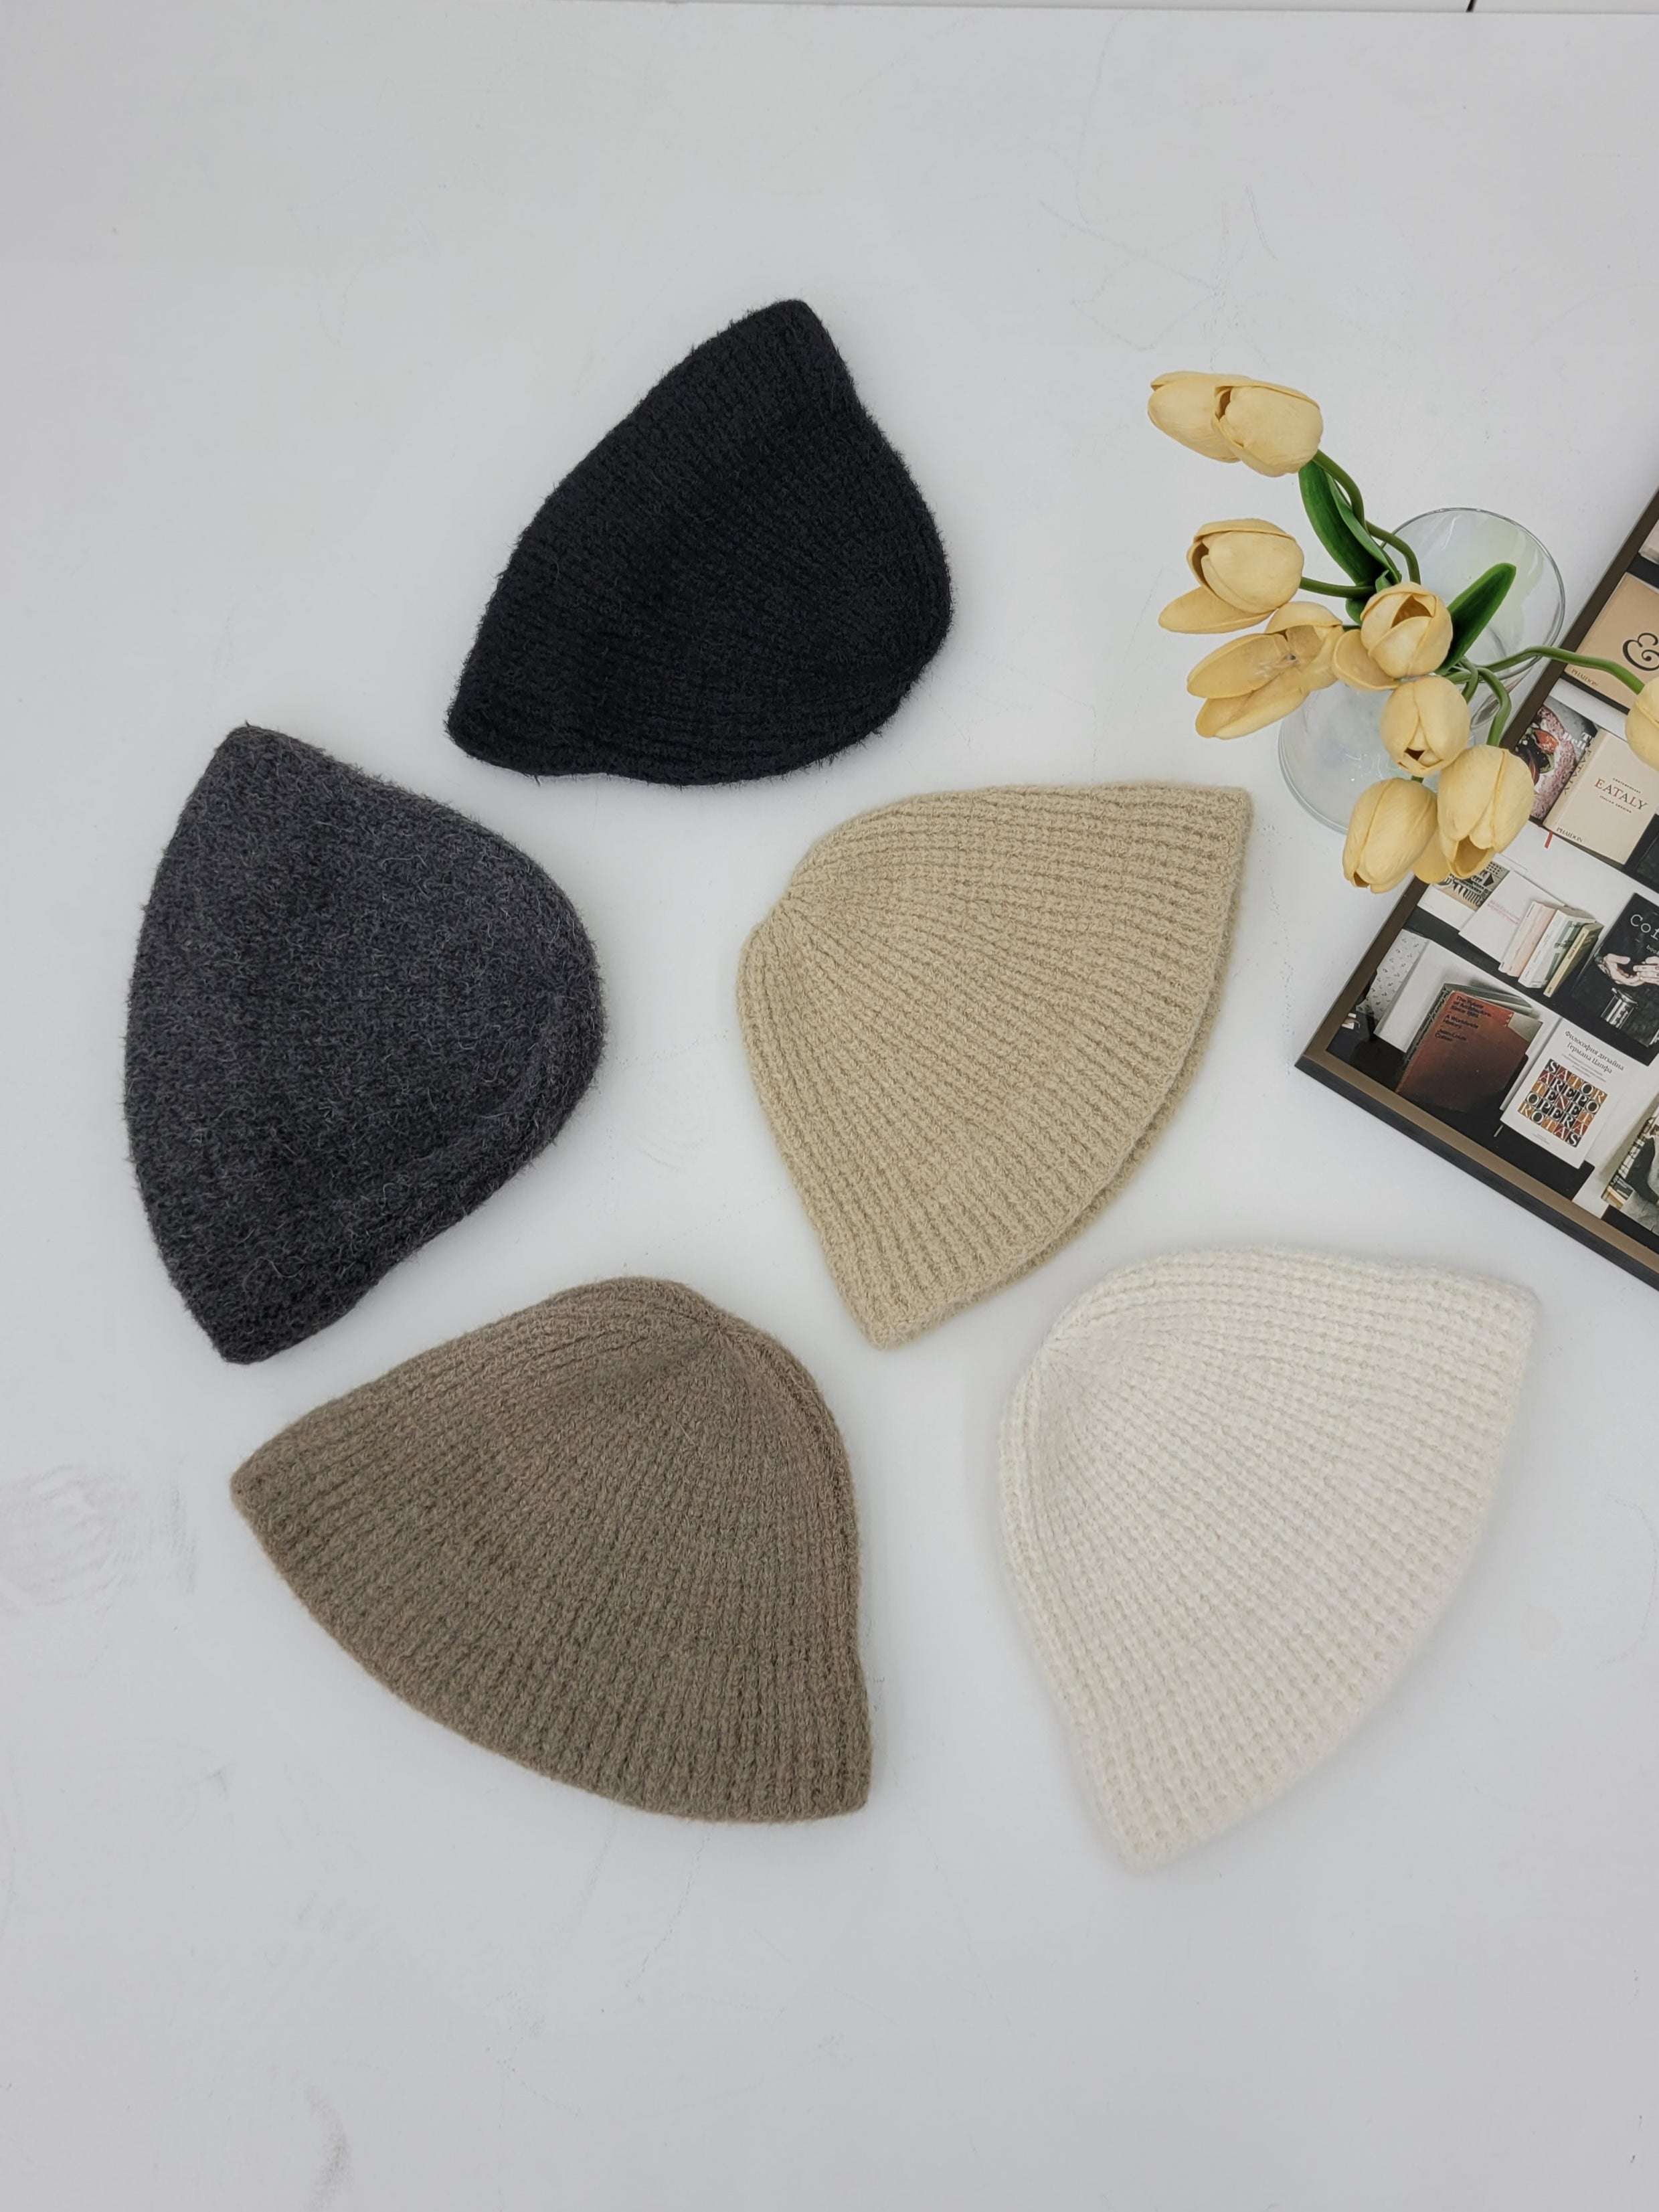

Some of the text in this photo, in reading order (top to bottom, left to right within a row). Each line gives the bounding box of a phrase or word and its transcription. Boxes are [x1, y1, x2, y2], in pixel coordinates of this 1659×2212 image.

[1594, 778, 1648, 810] EATALY
[1556, 827, 1583, 843] PHAIDON
[1565, 1031, 1599, 1055] Философия
[1597, 1053, 1624, 1071] дизайна
[1567, 1042, 1591, 1061] Германа
[1591, 1057, 1612, 1074] Цапфа
[1534, 1081, 1593, 1122] TENET
[1539, 1072, 1599, 1113] AREPO
[1547, 1060, 1605, 1104] SATOR
[1520, 1103, 1579, 1146] ROTAS
[1526, 1092, 1587, 1136] OPERA
